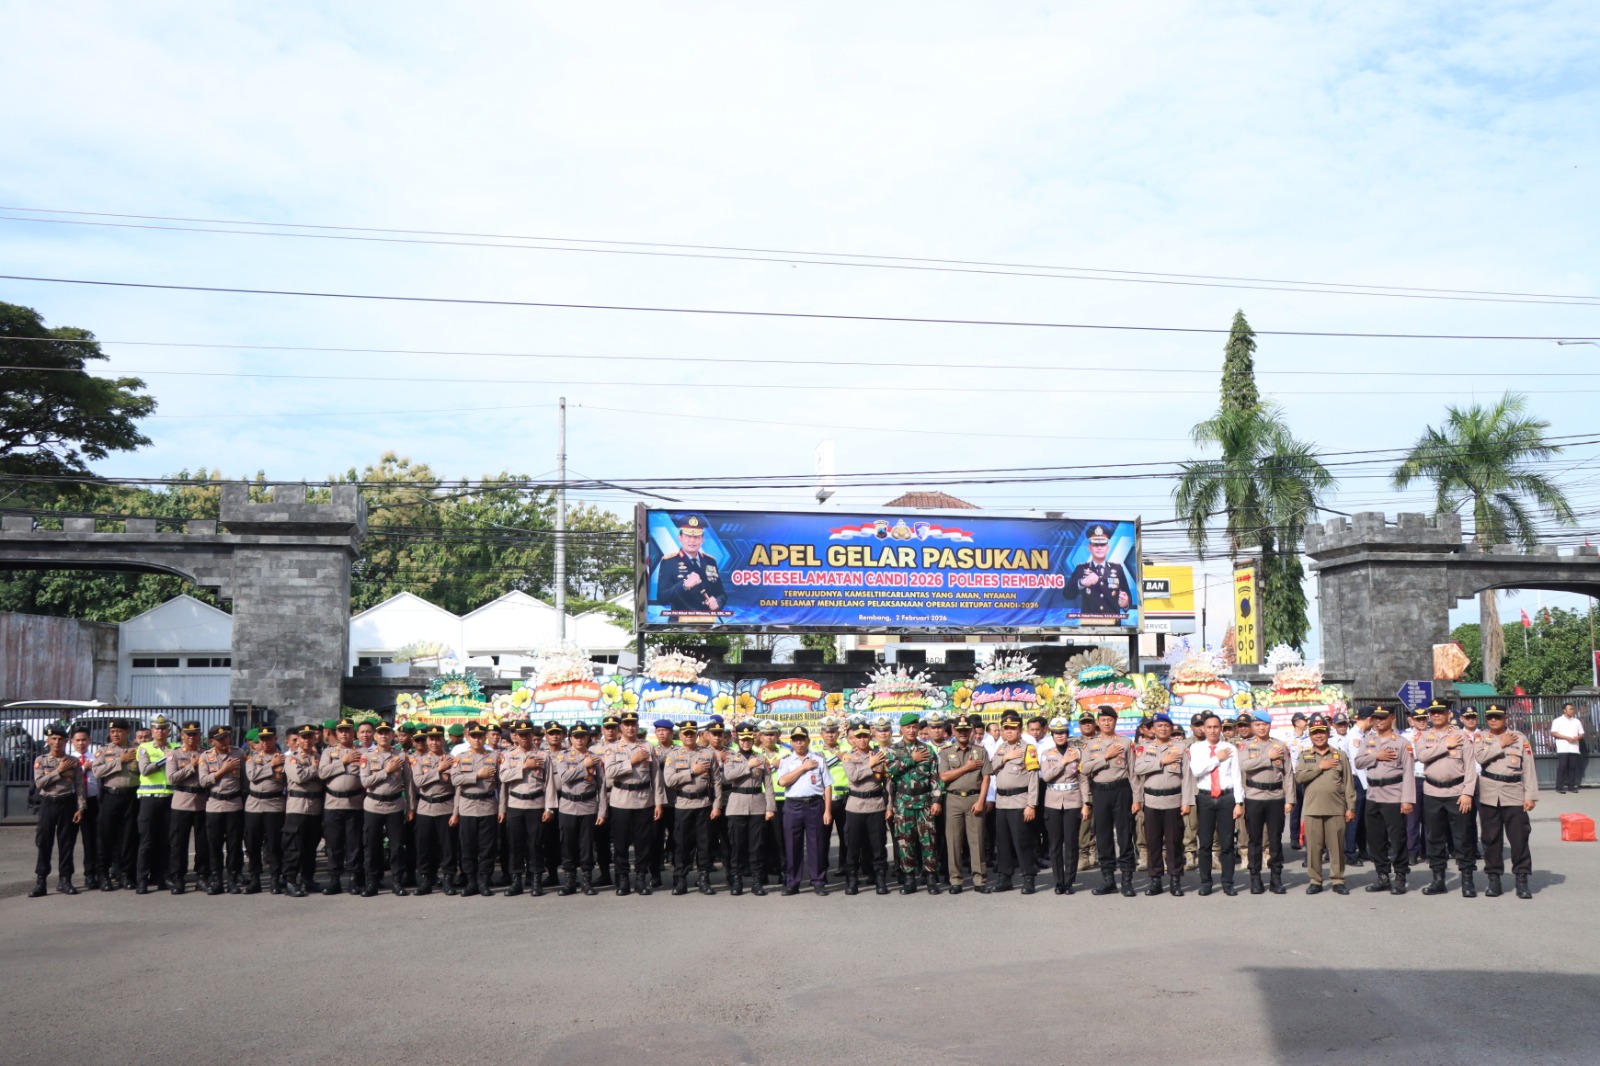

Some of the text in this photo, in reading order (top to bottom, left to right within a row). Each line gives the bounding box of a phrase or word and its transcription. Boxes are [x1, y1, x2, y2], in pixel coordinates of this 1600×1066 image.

[750, 544, 1049, 570] APEL GELAR PASUKAN
[732, 571, 1065, 588] OPS KESELAMATAN CANDI 2026 POLRES REMBANG
[1146, 582, 1164, 590] BAN
[955, 592, 981, 600] AMAN,
[858, 614, 892, 622] Rembang,
[642, 685, 673, 702] Selamat
[761, 683, 791, 702] Selamat
[971, 689, 1003, 706] Selamat
